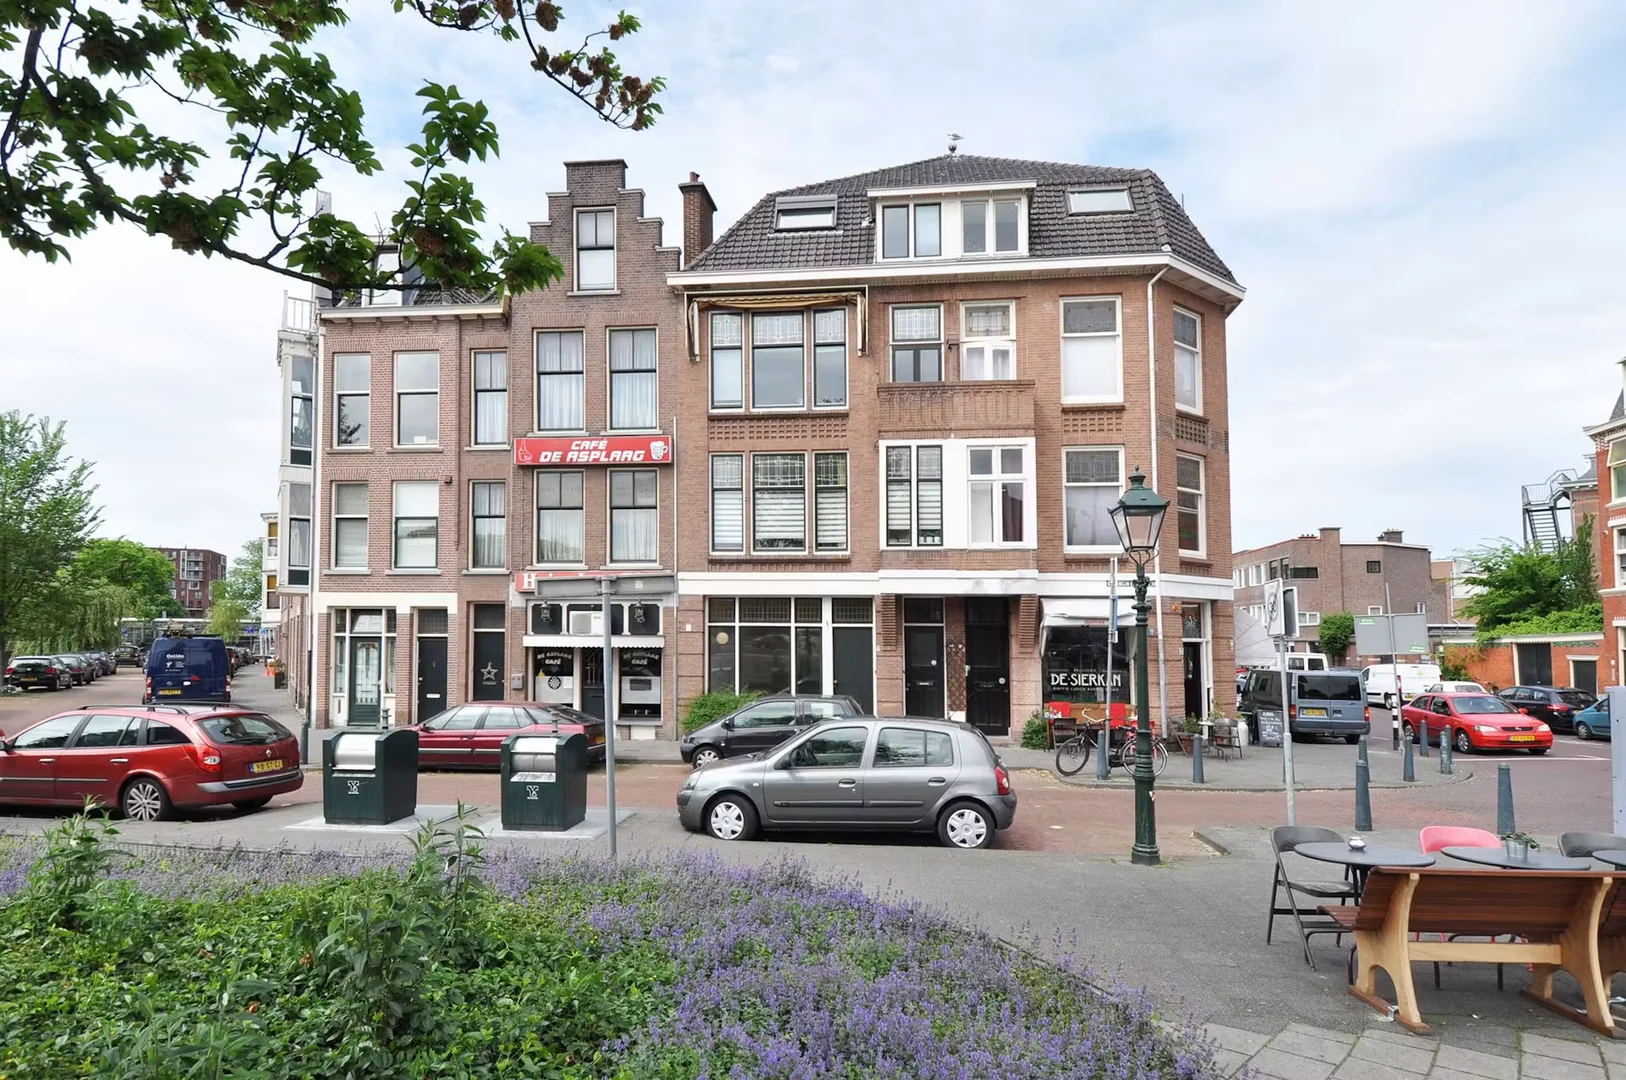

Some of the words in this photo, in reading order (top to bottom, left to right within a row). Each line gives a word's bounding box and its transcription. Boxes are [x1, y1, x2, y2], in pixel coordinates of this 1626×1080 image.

[571, 439, 608, 450] CAFÉ
[539, 451, 563, 462] DE
[566, 450, 646, 462] ASPLAAG
